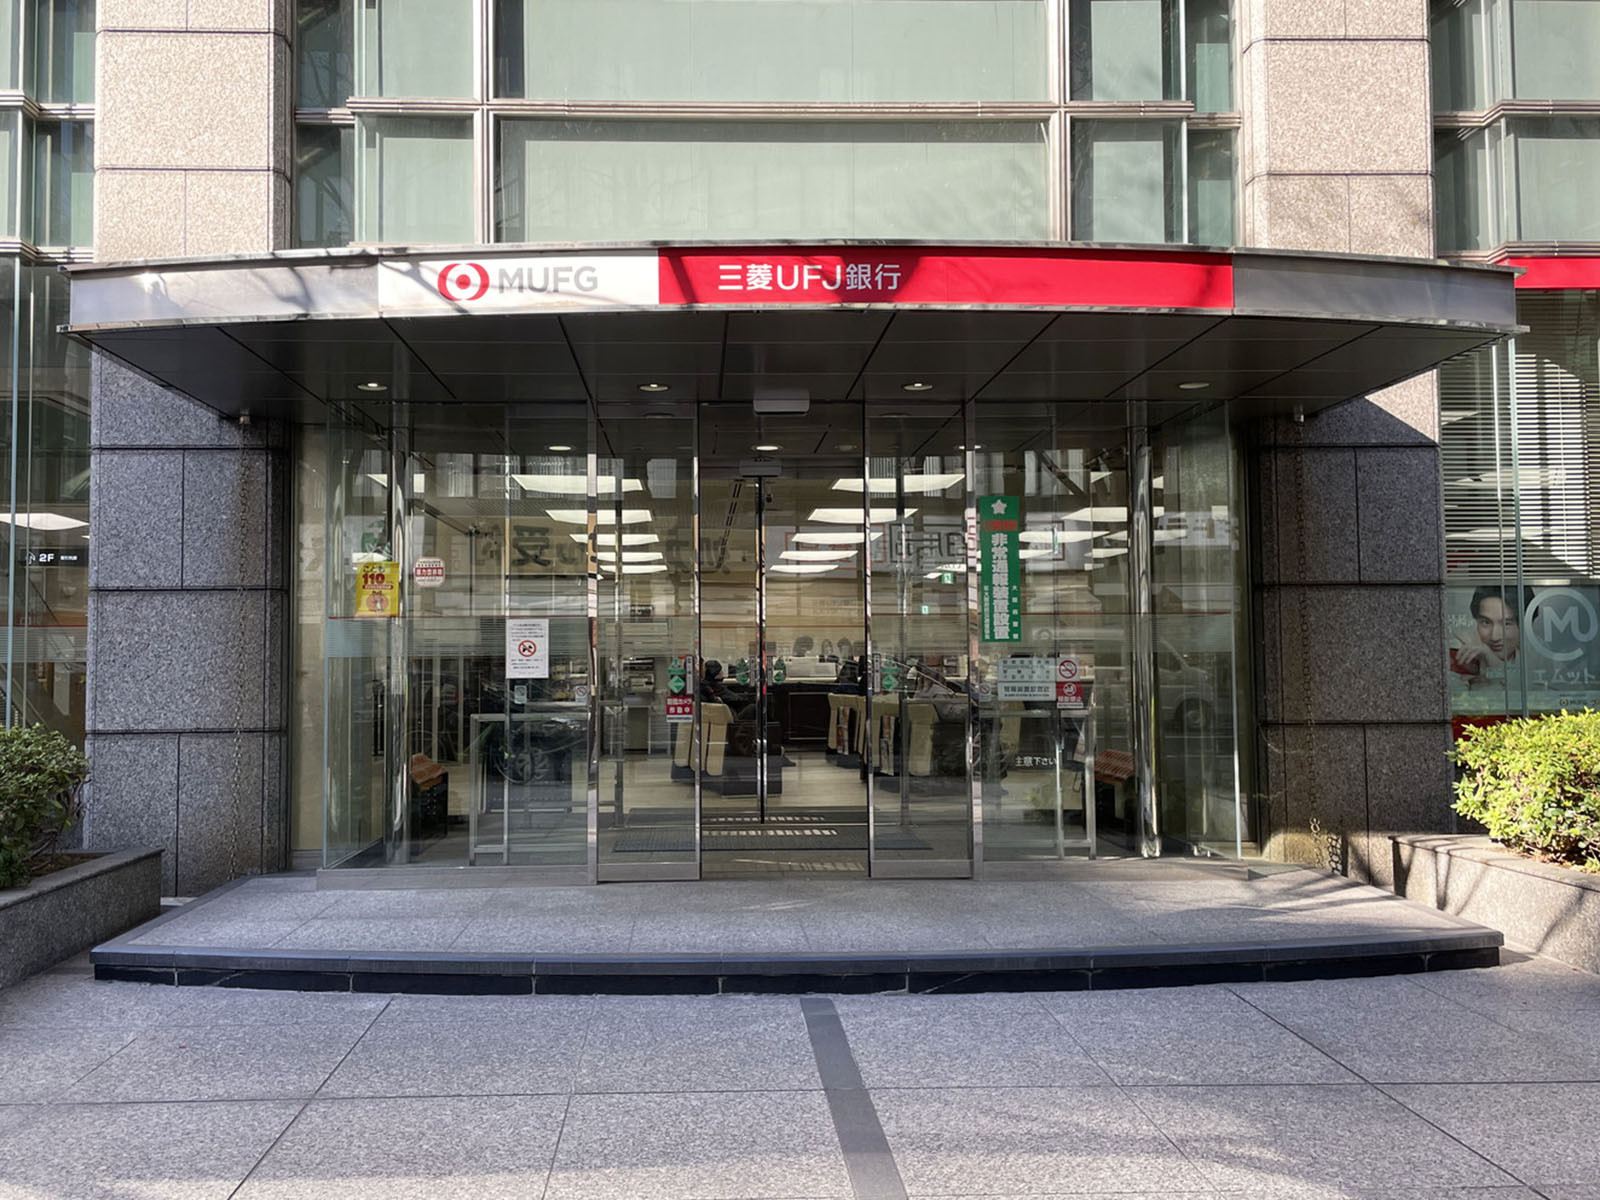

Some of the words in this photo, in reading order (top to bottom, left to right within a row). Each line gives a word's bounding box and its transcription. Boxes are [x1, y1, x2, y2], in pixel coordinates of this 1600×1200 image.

[499, 265, 598, 293] MUFG
[717, 263, 902, 292] 三菱UFJ銀行
[39, 554, 55, 562] 2F
[362, 573, 386, 584] 110
[1534, 668, 1596, 683] エムット
